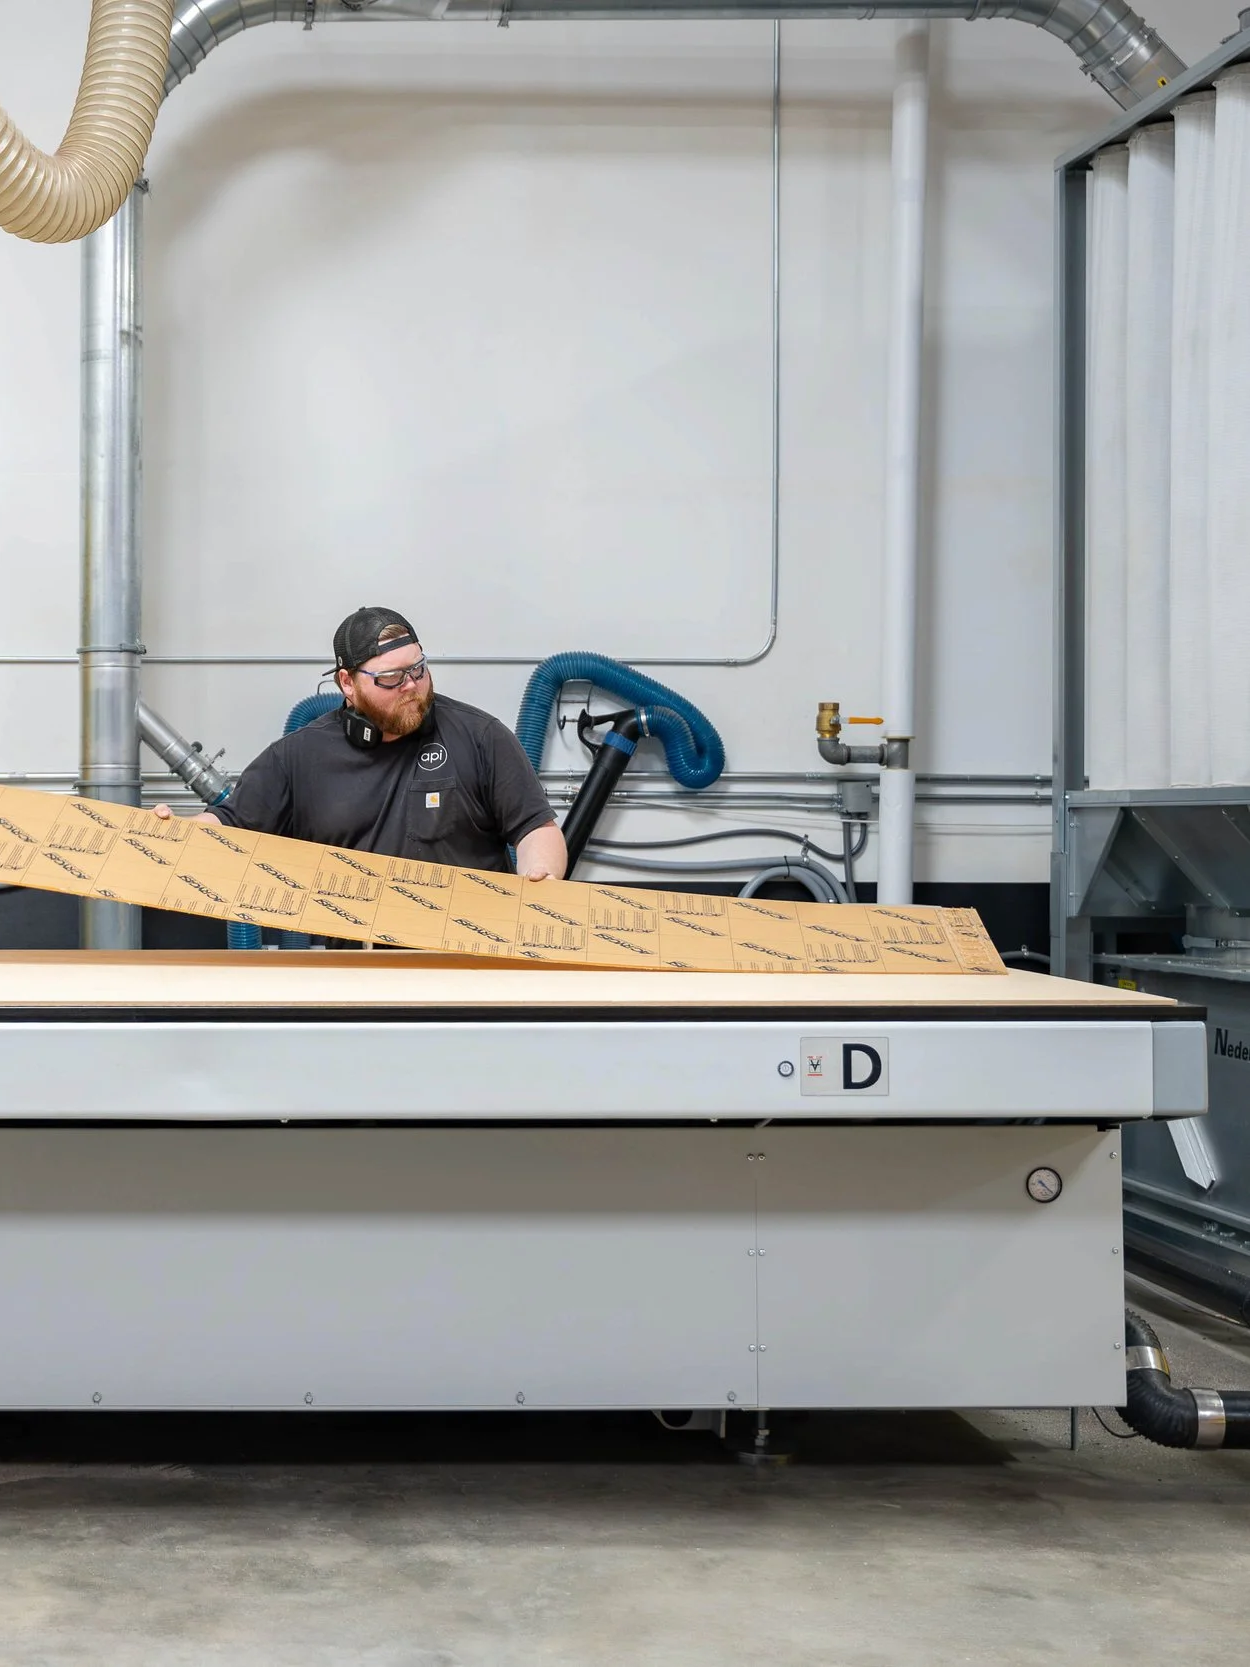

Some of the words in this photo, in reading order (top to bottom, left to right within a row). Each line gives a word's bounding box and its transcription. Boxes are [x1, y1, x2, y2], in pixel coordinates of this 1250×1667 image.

[421, 749, 443, 764] api
[1214, 1027, 1250, 1061] Nede
[843, 1043, 882, 1090] D
